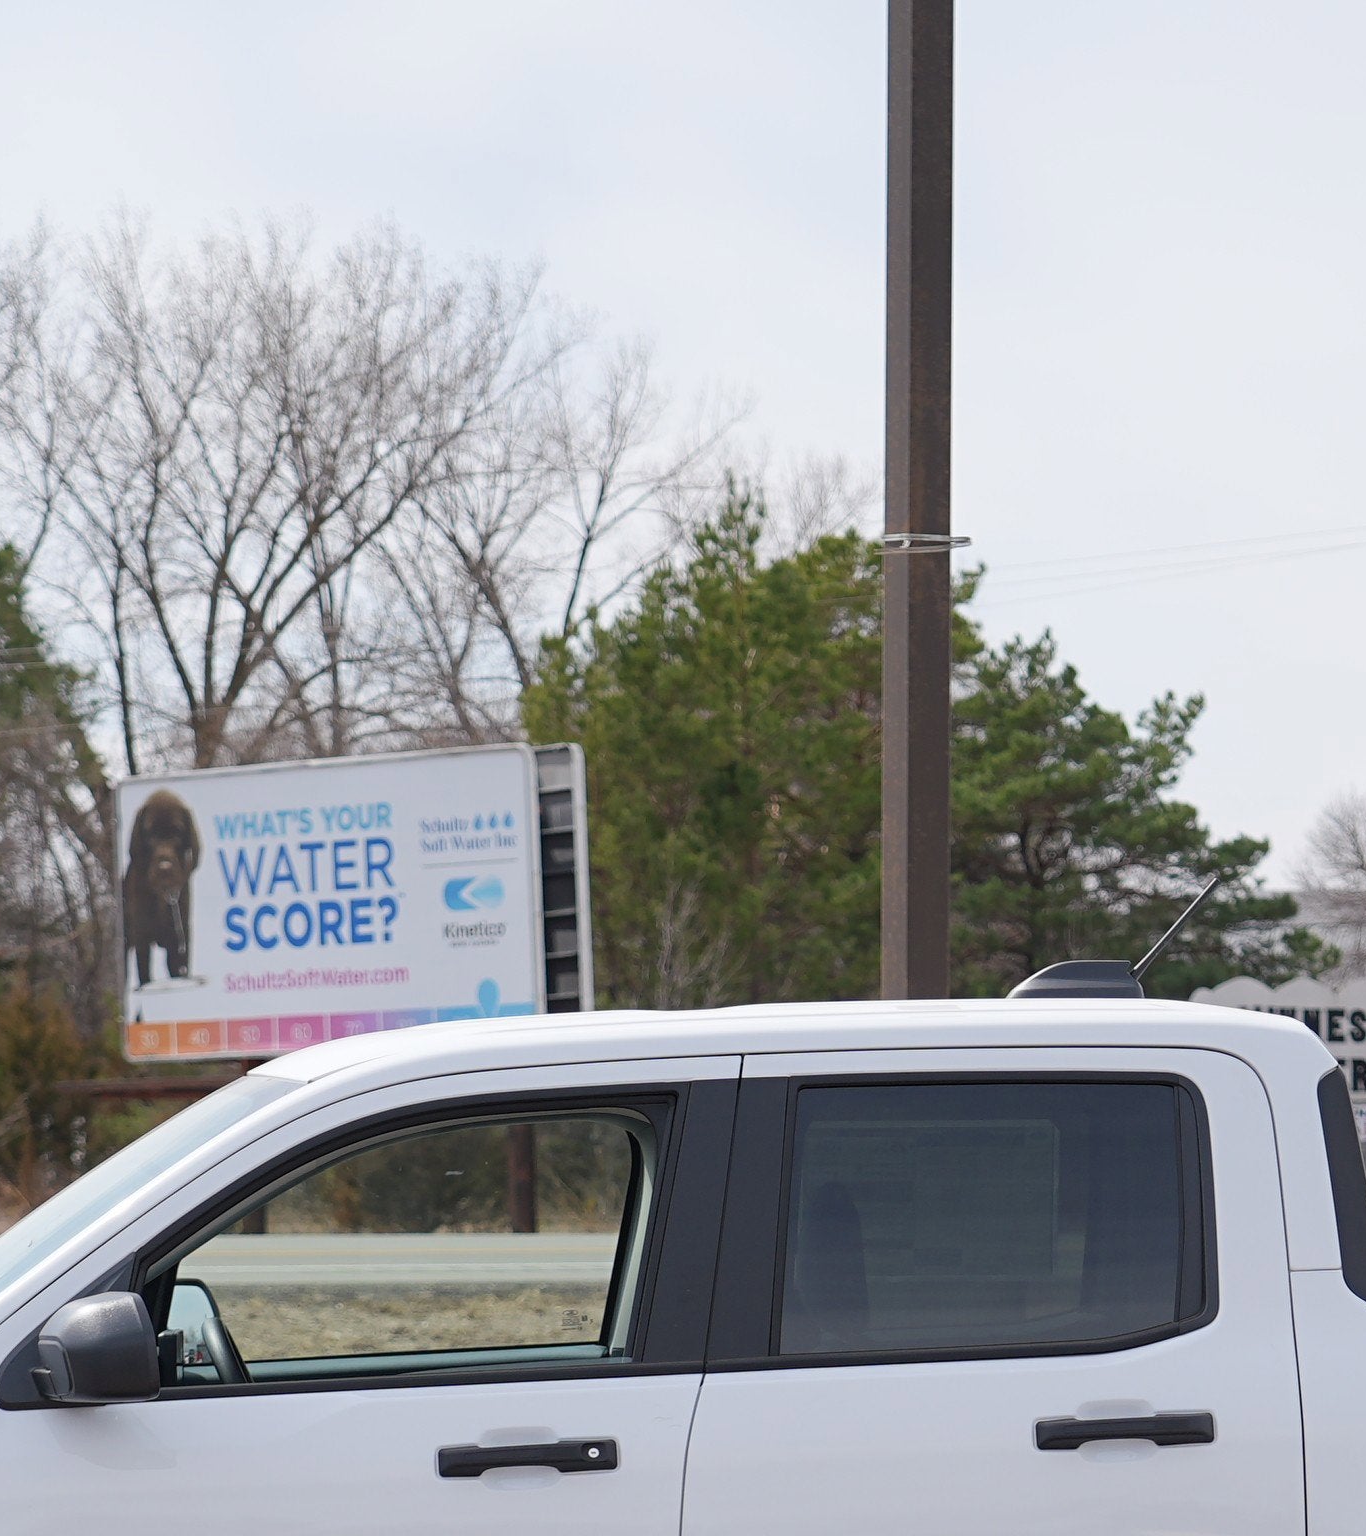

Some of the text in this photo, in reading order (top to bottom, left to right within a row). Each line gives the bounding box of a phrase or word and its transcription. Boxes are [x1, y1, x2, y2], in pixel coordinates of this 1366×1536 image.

[215, 802, 392, 840] WHAT'S YOUR
[420, 815, 468, 833] Schultz
[421, 831, 517, 852] Soft Water Inc
[219, 837, 395, 898] WATER
[225, 897, 398, 952] SCORE?
[445, 921, 506, 938] Kinetico
[225, 966, 410, 993] SchultzSoftWater.com
